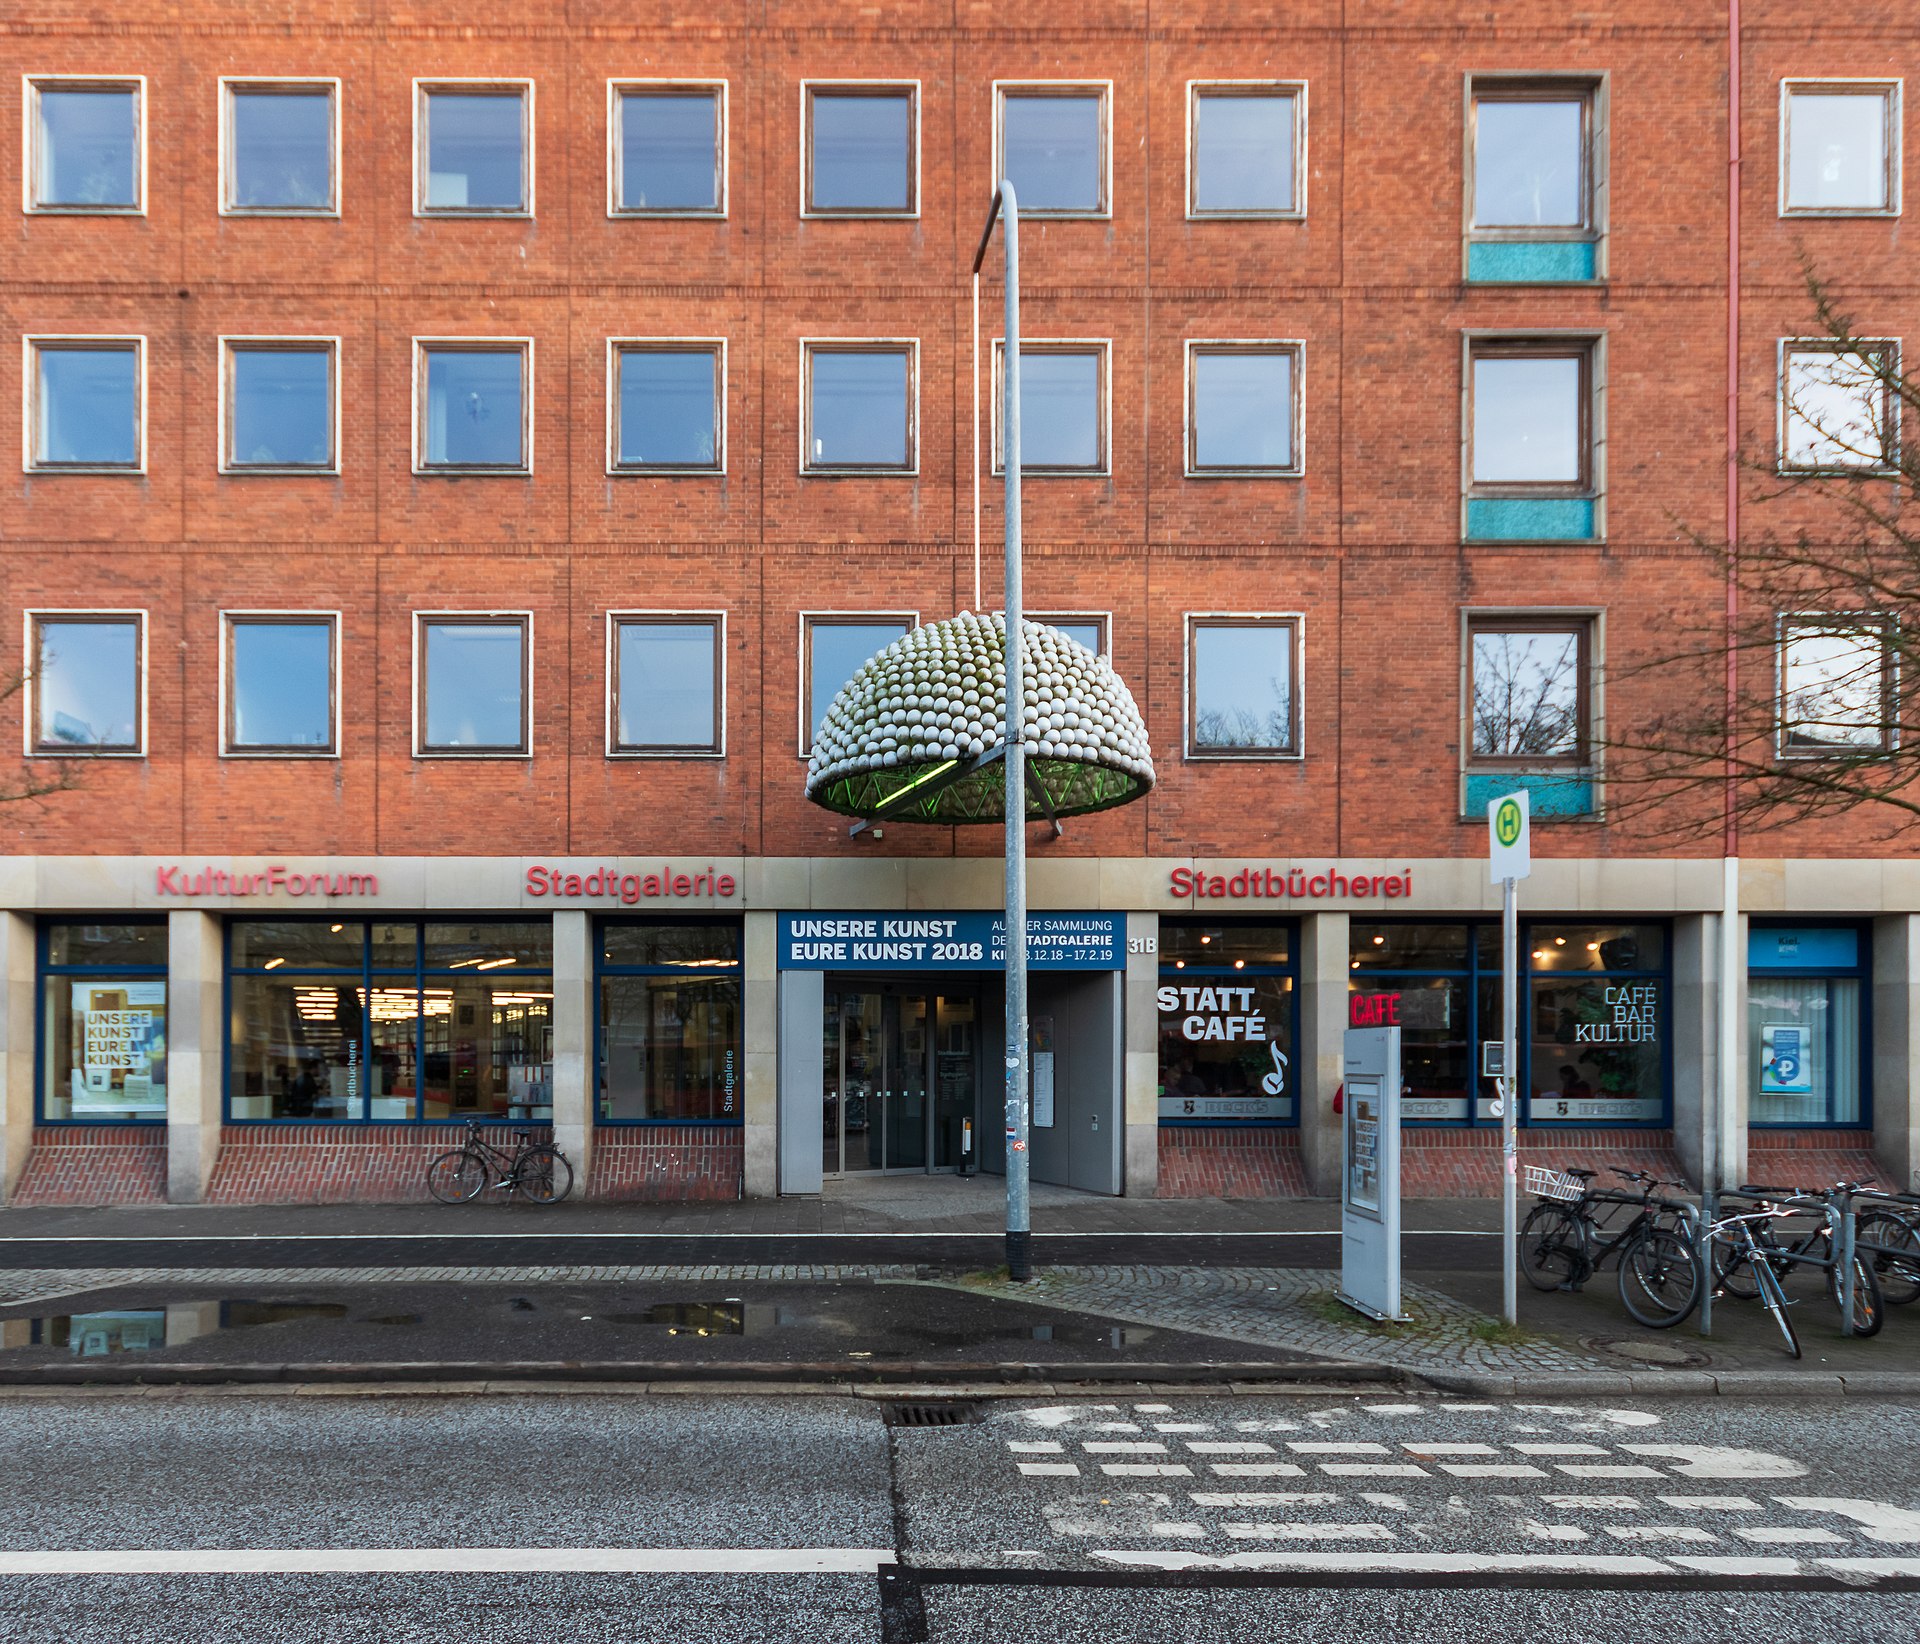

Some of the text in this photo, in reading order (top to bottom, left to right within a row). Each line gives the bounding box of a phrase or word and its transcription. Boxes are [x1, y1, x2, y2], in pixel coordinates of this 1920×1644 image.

[156, 865, 379, 896] KulturForum
[526, 865, 736, 904] Stadtgalerie
[1170, 867, 1413, 898] Stadtbücherei
[791, 920, 957, 938] UNSERE KUNST
[1044, 920, 1113, 931] SAMMLUNG
[1026, 935, 1113, 946] TADTGALERIE
[1128, 937, 1157, 954] 31B
[791, 943, 984, 960] EURE KUNST 2018
[1157, 986, 1255, 1012] STATT
[1605, 982, 1656, 1005] CAFÉ
[88, 1013, 149, 1025] UNSERE
[1613, 1005, 1656, 1023] BAR
[88, 1027, 141, 1038] KUNST
[1183, 1009, 1266, 1041] CAFÉ
[1575, 1024, 1656, 1042] KULTUR
[88, 1041, 127, 1052] EURE
[88, 1055, 139, 1066] KUNST
[724, 1050, 735, 1112] Stadtgalerie
[1400, 1101, 1449, 1114] ECK'S
